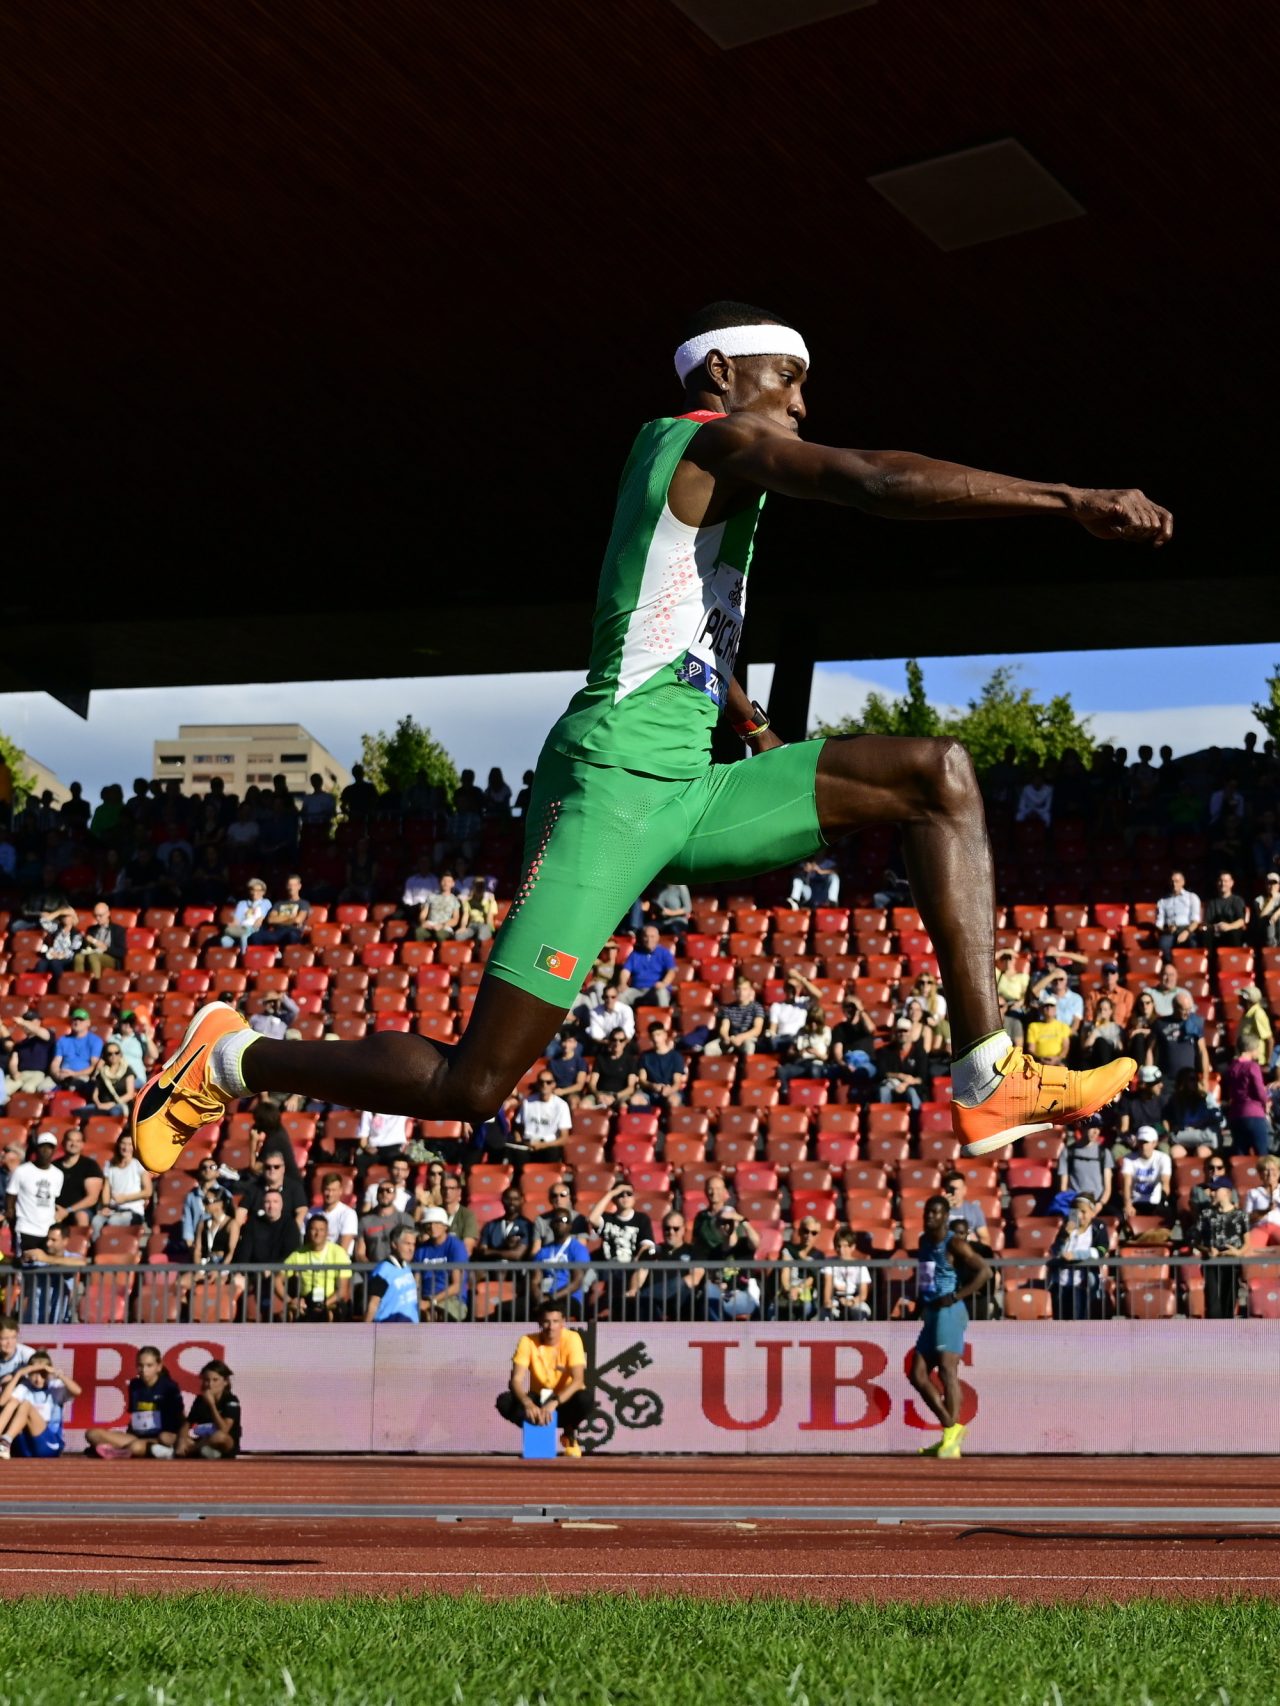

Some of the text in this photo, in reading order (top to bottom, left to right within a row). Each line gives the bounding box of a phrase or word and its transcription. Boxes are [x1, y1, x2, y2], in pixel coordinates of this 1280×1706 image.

[698, 607, 741, 670] PICH
[20, 1340, 226, 1430] BS
[688, 1340, 978, 1431] UBS
